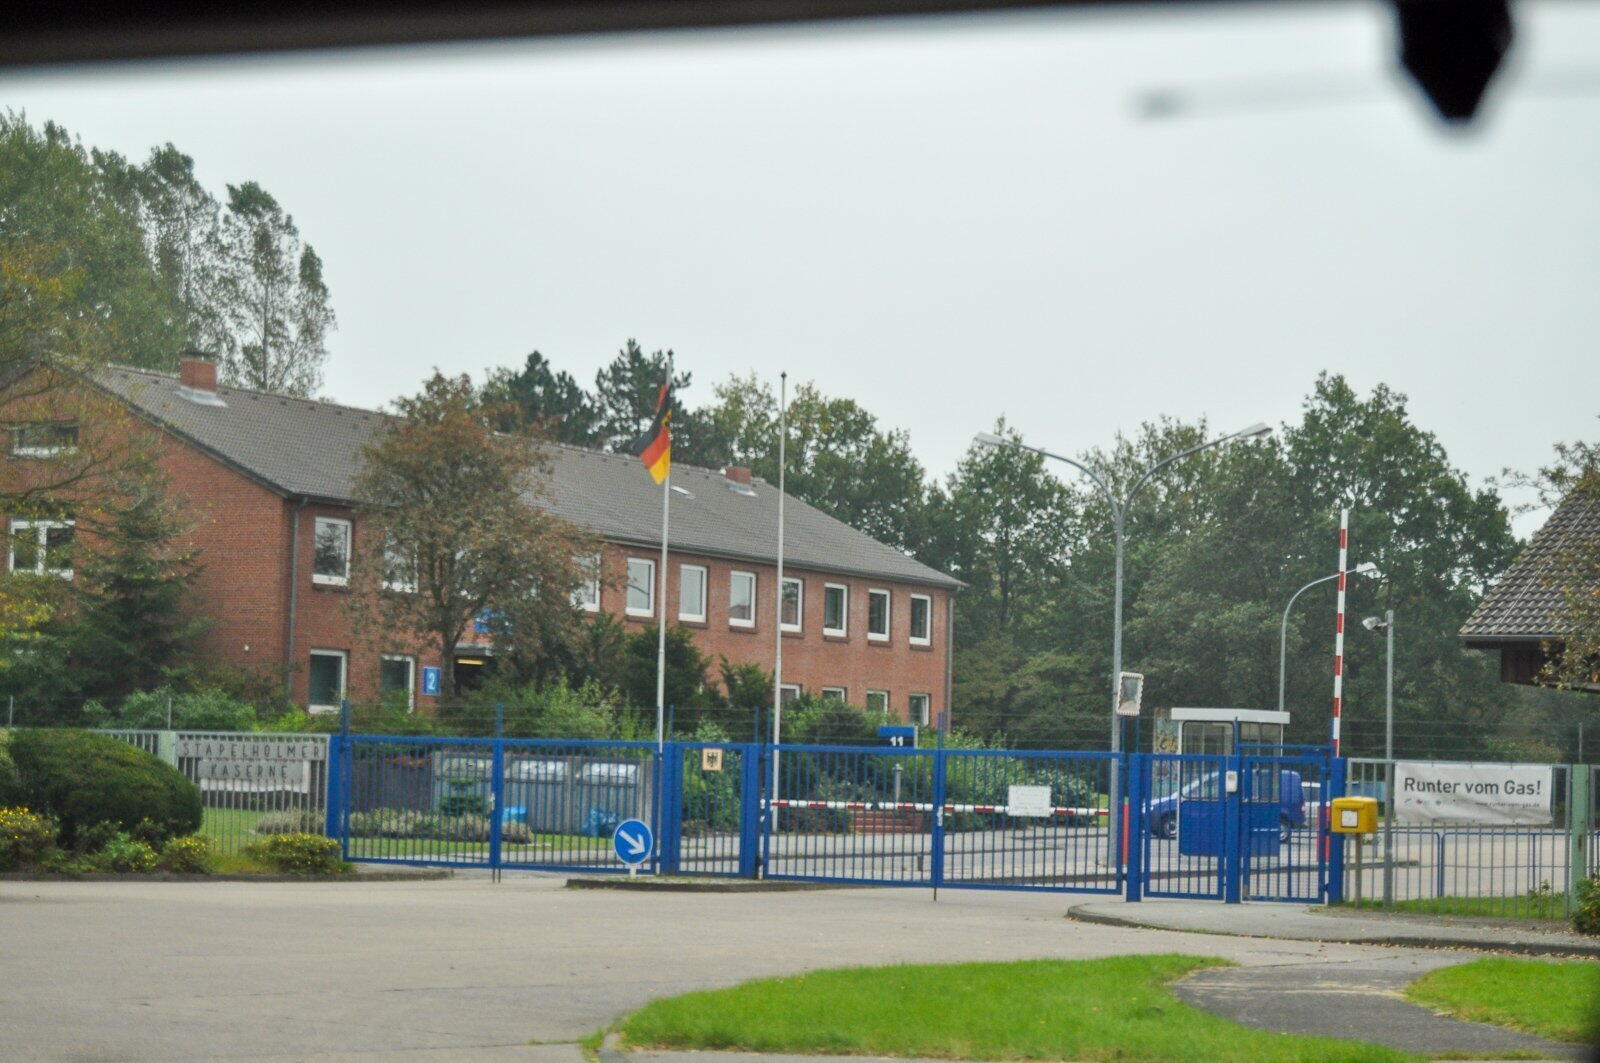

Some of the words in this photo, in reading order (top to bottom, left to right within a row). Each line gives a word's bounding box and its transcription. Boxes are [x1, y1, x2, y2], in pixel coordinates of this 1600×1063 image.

[427, 672, 436, 690] 2
[889, 736, 904, 747] 11
[182, 743, 320, 758] STAPELHOLMER
[211, 763, 288, 778] KASERNE
[1404, 777, 1461, 794] Runter
[1466, 782, 1499, 795] vom
[1504, 780, 1541, 795] Gas!
